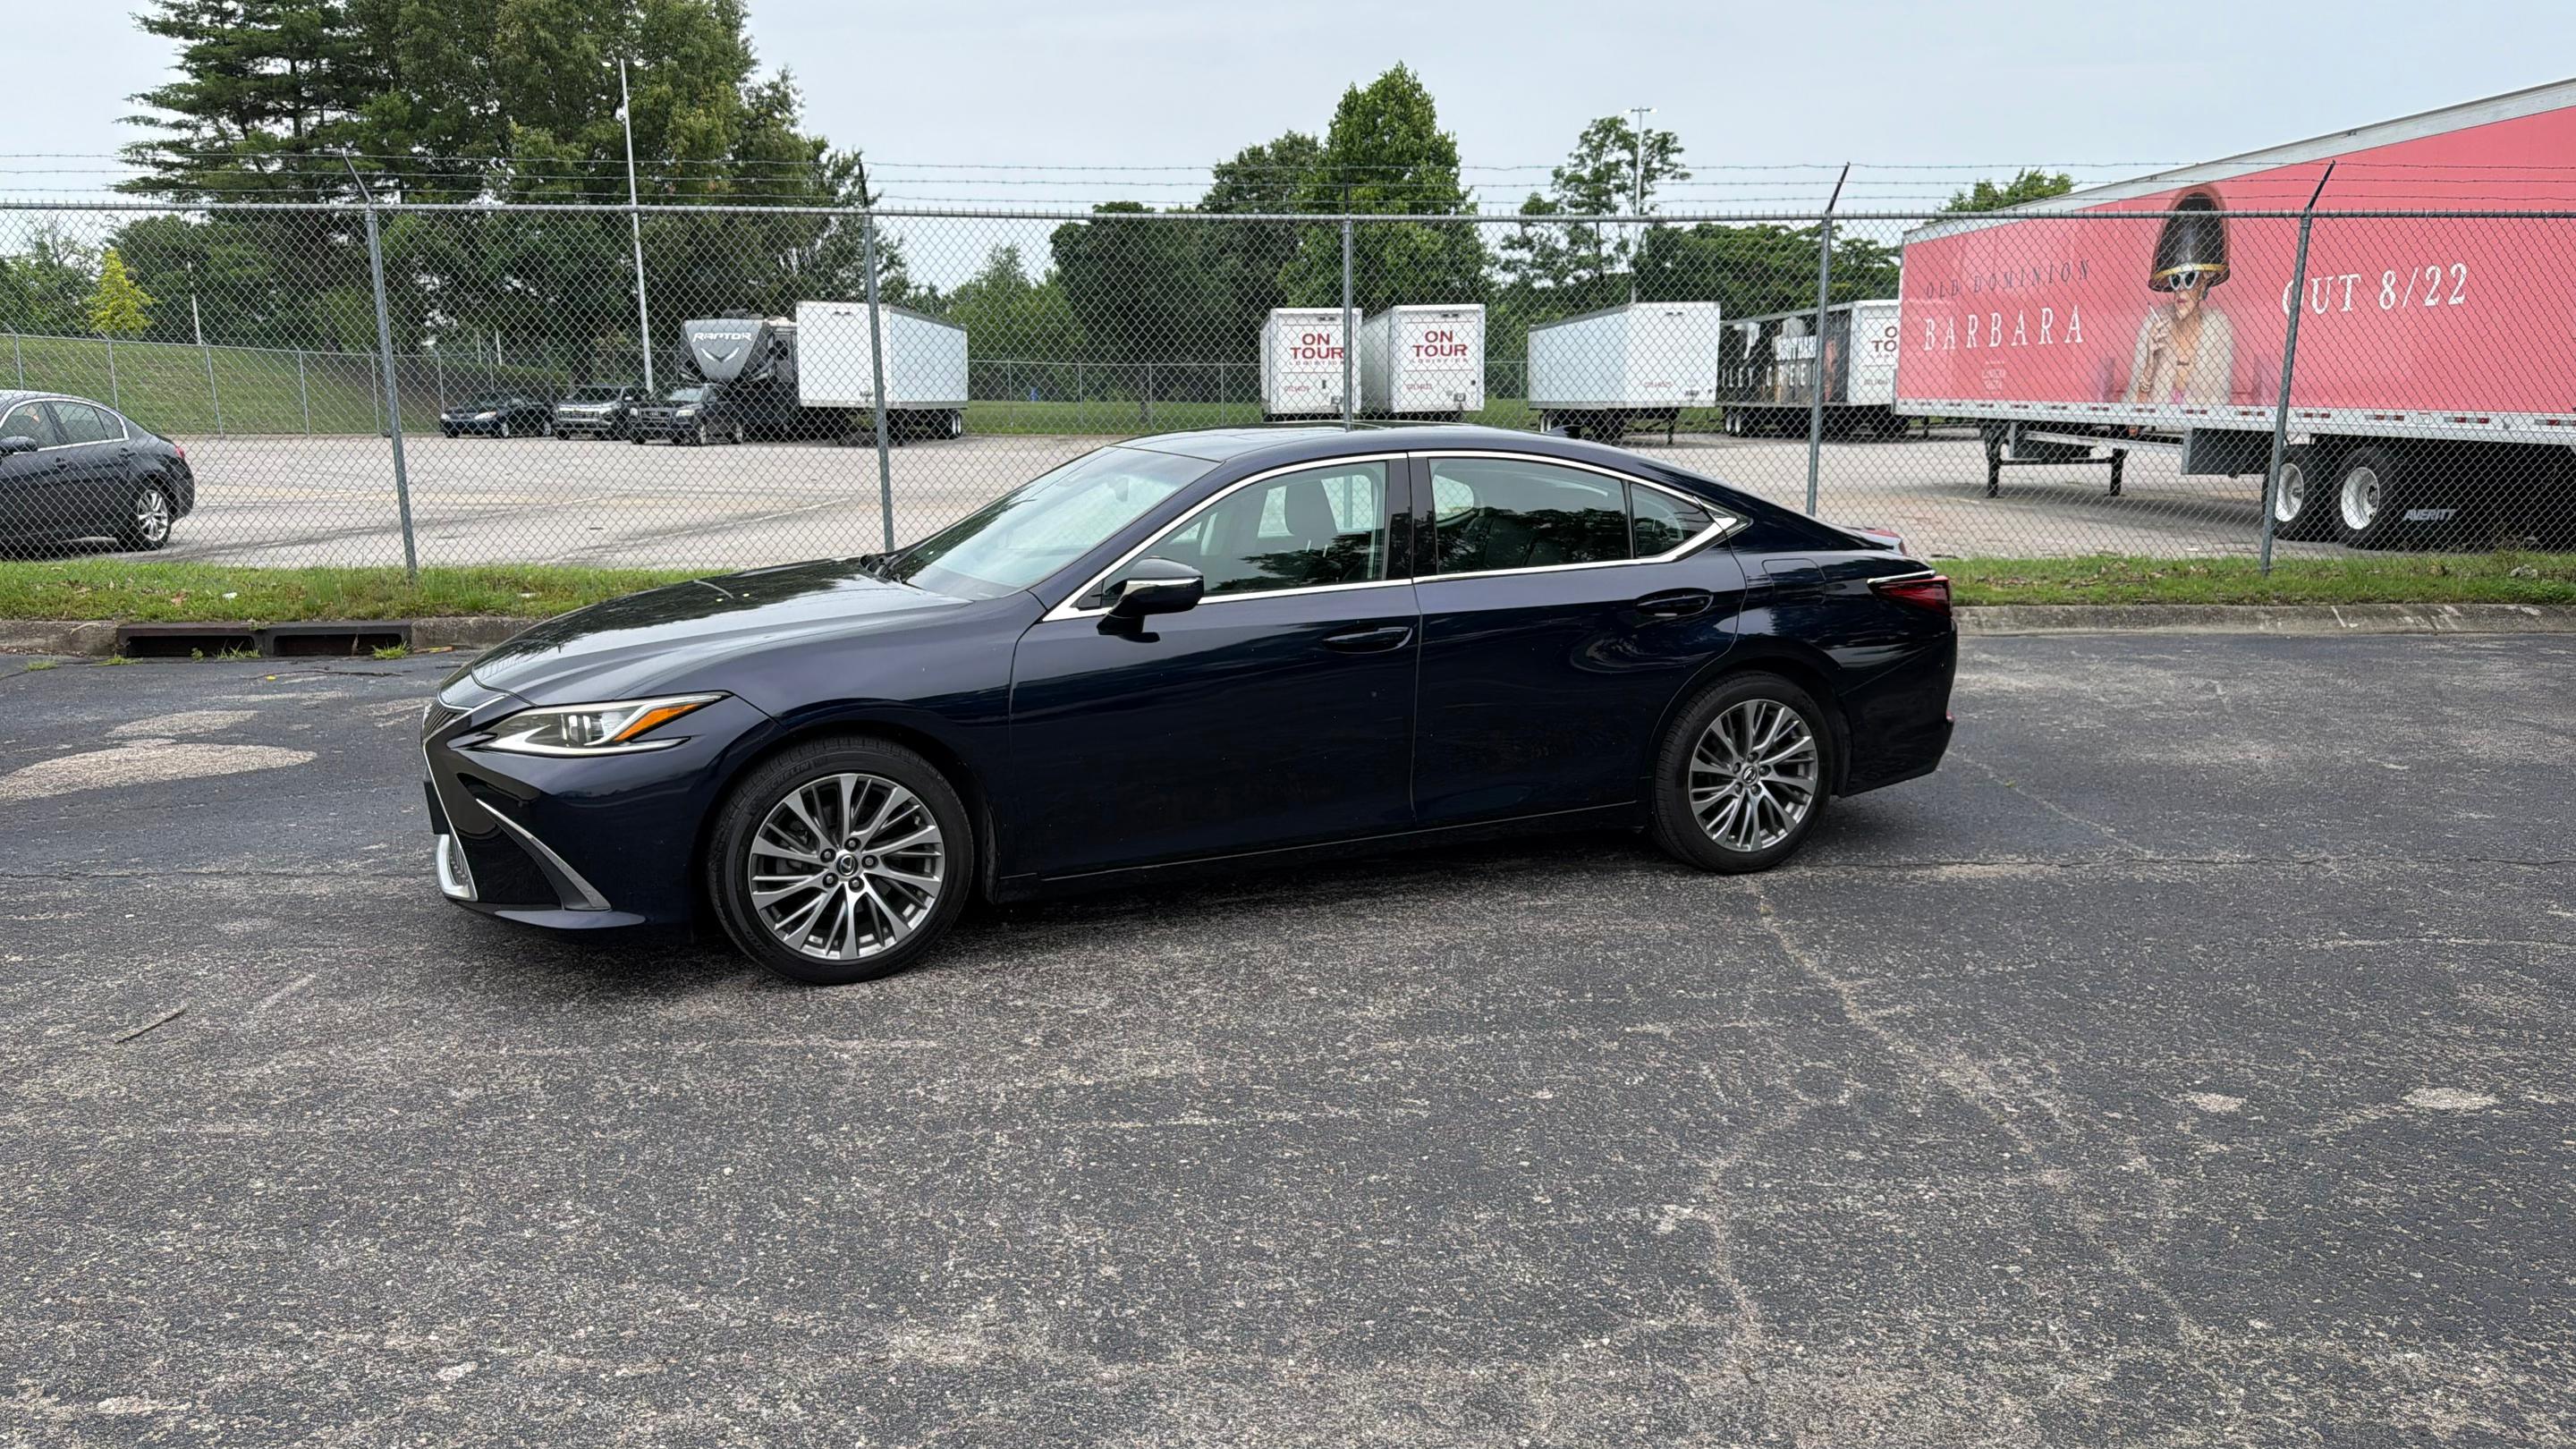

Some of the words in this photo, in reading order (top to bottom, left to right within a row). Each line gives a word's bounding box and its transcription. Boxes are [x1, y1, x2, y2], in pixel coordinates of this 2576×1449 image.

[1926, 279, 1960, 299] OLD
[1973, 258, 2089, 293] DOMINION
[2282, 272, 2362, 315] OUT
[2378, 262, 2468, 310] 8/22
[1884, 326, 1898, 338] O
[1923, 304, 2084, 351] BARBARA
[692, 332, 752, 343] RAPTOR
[1301, 333, 1331, 346] ON
[1424, 330, 1453, 343] ON
[1289, 347, 1344, 360] TOUR
[1411, 343, 1469, 358] TOUR
[1718, 366, 1755, 388] ILEY
[1766, 363, 1817, 388] GREE
[2402, 508, 2457, 521] AVERITT
